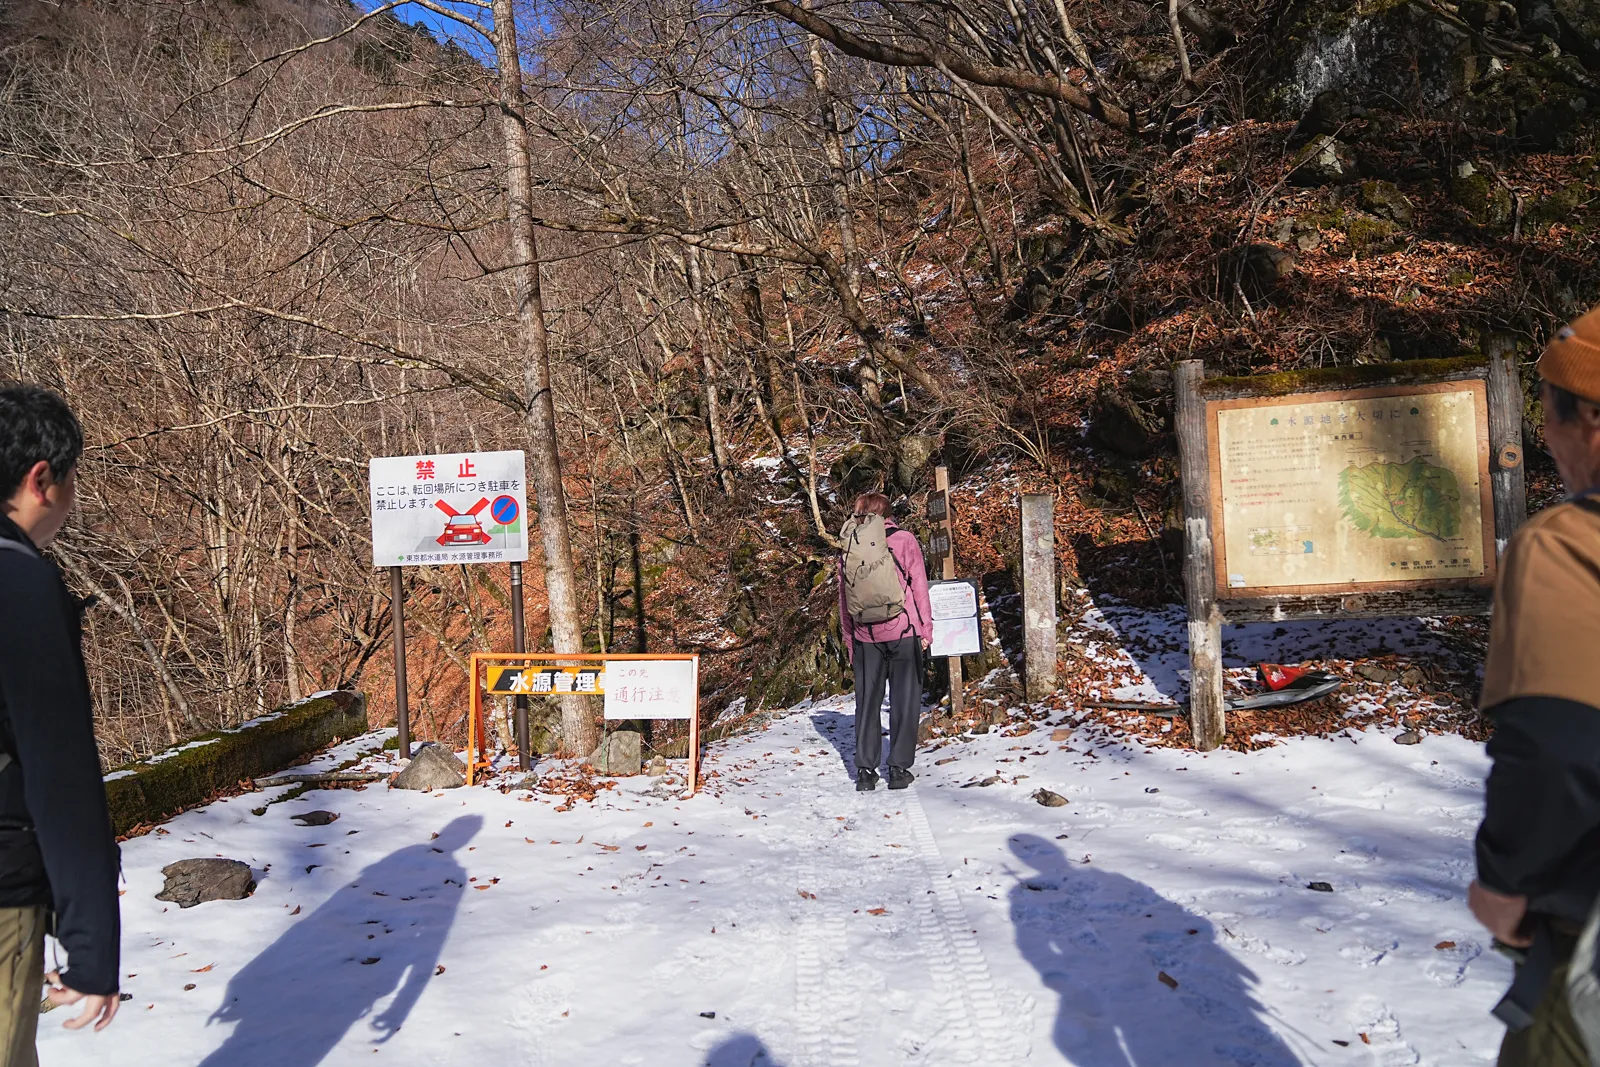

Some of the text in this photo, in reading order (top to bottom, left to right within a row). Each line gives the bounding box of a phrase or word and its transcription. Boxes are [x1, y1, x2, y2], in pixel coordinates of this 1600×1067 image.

[1286, 408, 1402, 428] 水源地を大切に
[415, 458, 477, 480] 禁止
[376, 480, 521, 497] ここは、転回場所につき駐車を
[376, 498, 435, 511] 禁止します。
[406, 550, 503, 562] 東京都水道局 水源管理事務所
[619, 668, 649, 679] この先
